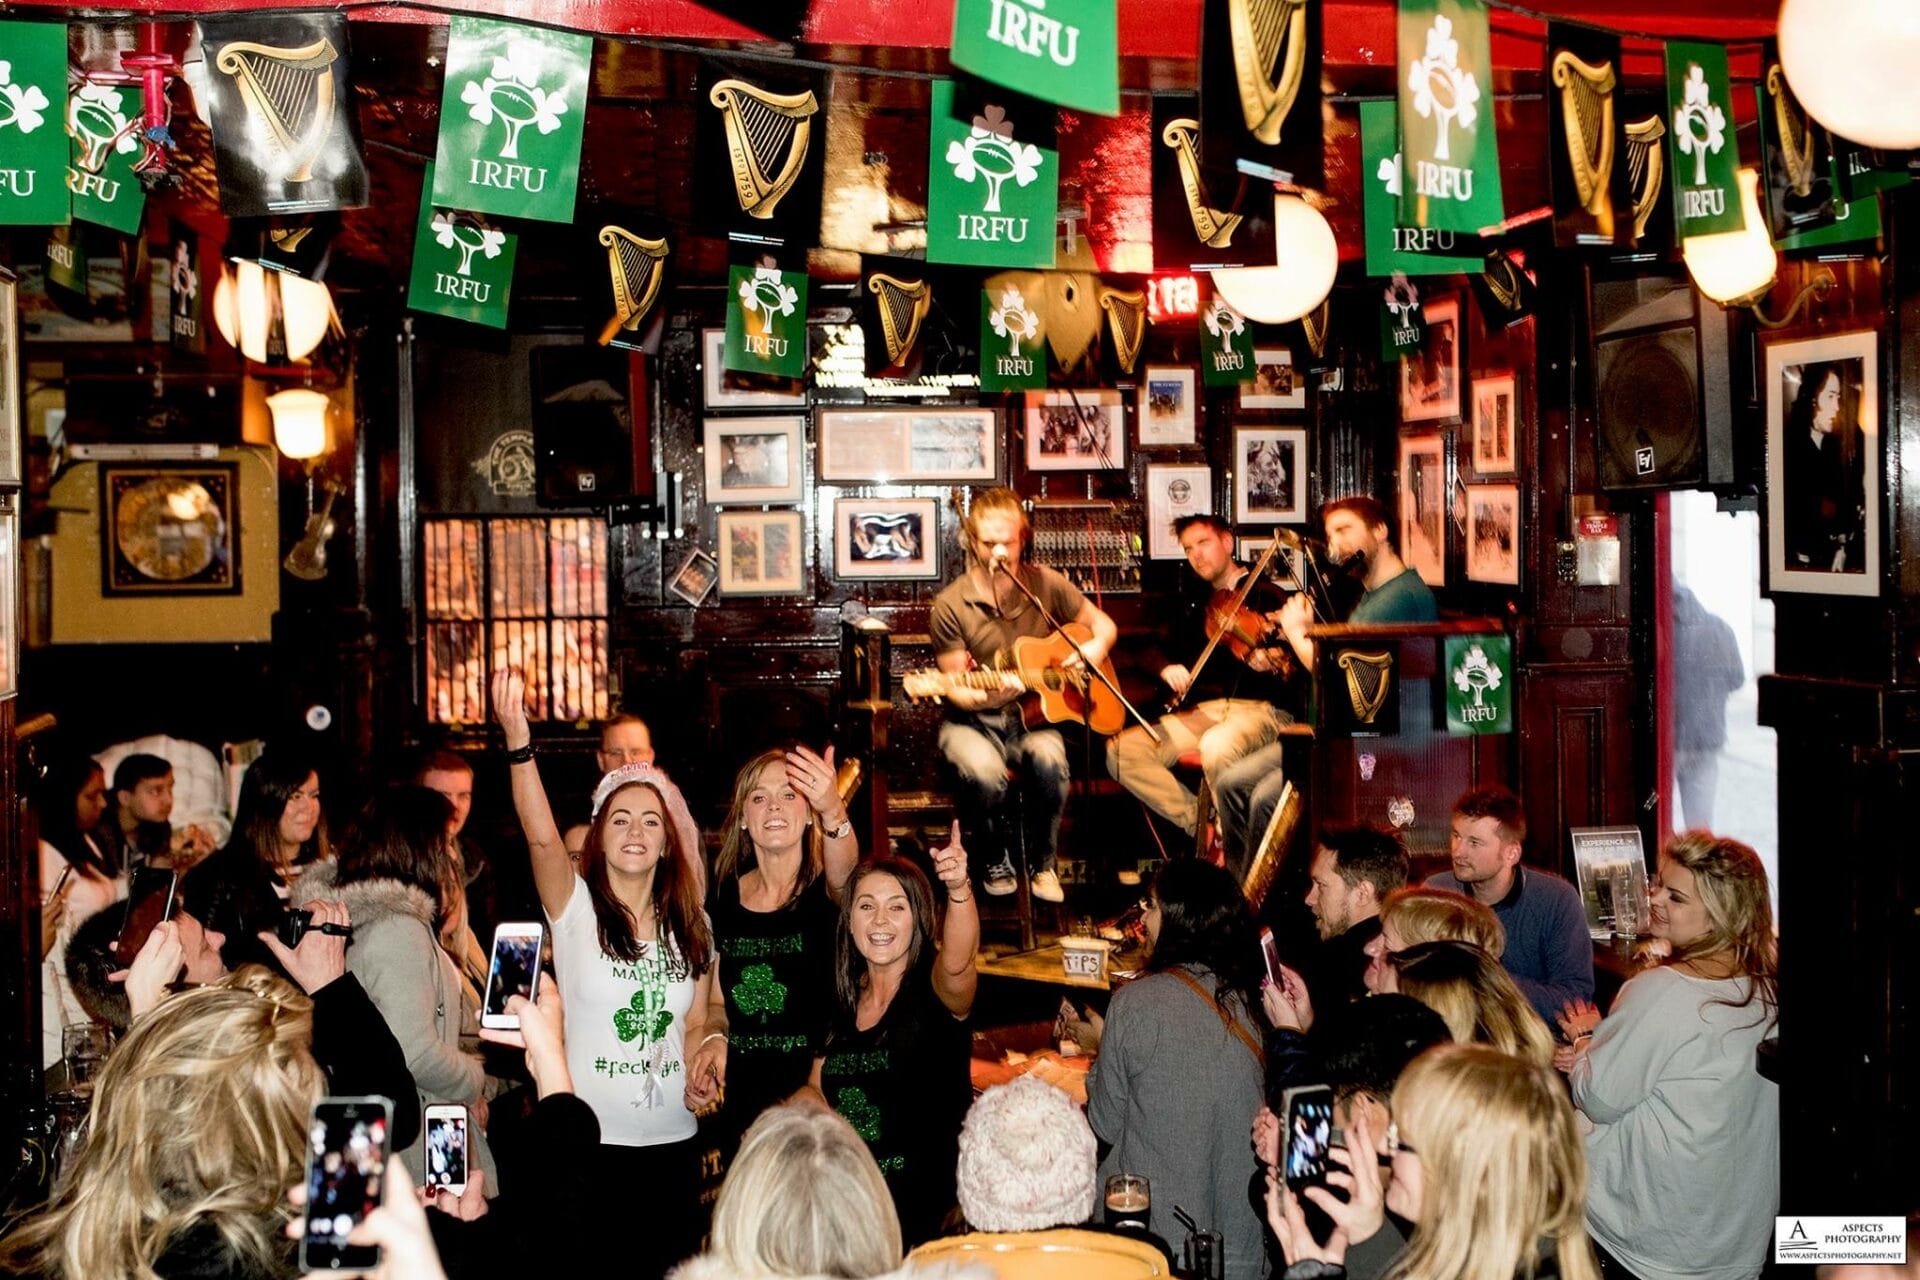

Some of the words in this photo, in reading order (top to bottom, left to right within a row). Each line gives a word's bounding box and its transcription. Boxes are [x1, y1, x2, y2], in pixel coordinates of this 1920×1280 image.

[986, 0, 1080, 66] IRFU
[65, 166, 120, 203] RFU
[468, 158, 548, 192] IRFU
[738, 171, 753, 198] 1759
[1416, 160, 1473, 201] IRFU
[1681, 188, 1725, 218] IRFU
[957, 214, 1029, 243] IRFU
[1392, 227, 1455, 252] IRFU
[434, 272, 491, 303] IRFU
[174, 315, 196, 337] IRFU
[1393, 328, 1420, 346] IRFU
[744, 335, 789, 357] IRFU
[996, 358, 1034, 377] IRFU
[1214, 352, 1245, 372] IRFU
[1462, 706, 1498, 723] IRFU
[1581, 838, 1625, 848] EXPERIENCE
[612, 966, 686, 984] MARED
[595, 1056, 681, 1079] #feckye
